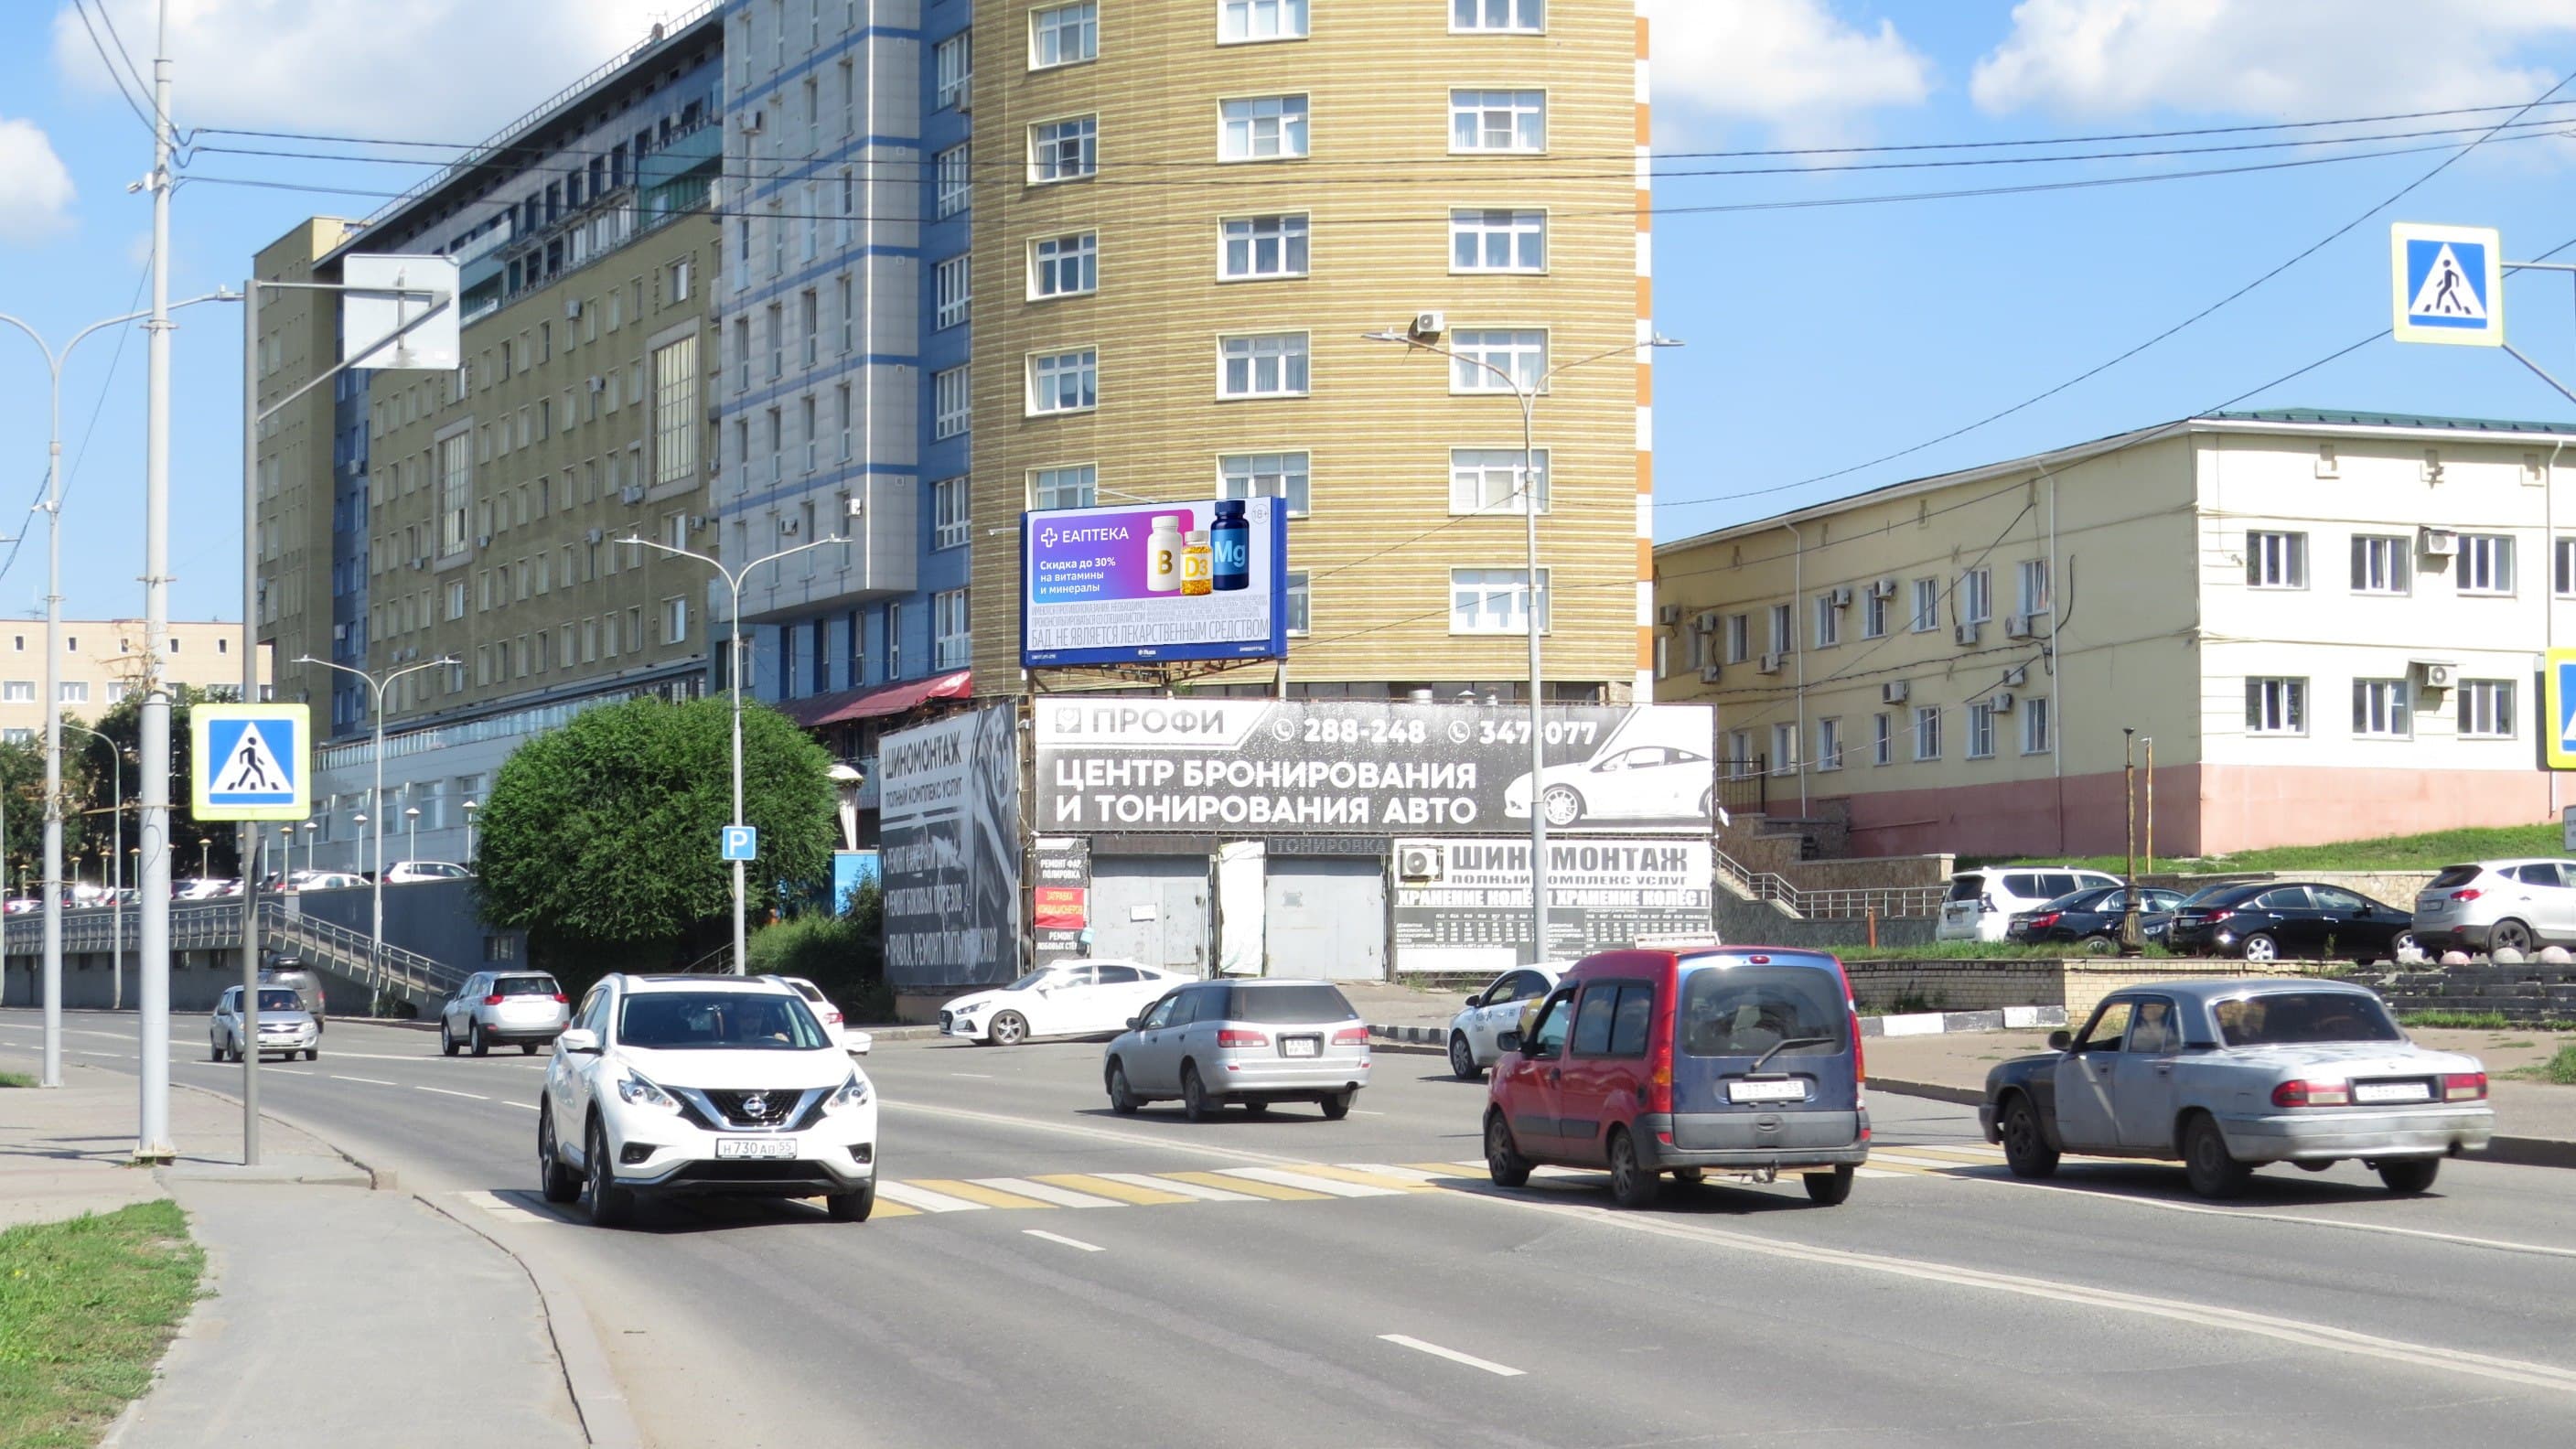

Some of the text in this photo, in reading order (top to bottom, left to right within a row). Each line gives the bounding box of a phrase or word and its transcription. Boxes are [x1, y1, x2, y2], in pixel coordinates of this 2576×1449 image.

[1062, 527, 1129, 542] ЕАПТЕКА
[1040, 556, 1116, 571] Скидка до 30%
[1214, 541, 1245, 567] Mg
[1185, 556, 1208, 577] D3
[1055, 572, 1104, 582] витамины
[1040, 585, 1100, 595] и минералы
[1032, 618, 1269, 649] БАД. НЕ ЯВЛЯЕТСЯ ЛЕКАРСТВЕННЫМ СРЕДСТВОМ
[1093, 708, 1224, 734] ПРОФИ
[1304, 719, 1597, 744] 288-248 347077
[885, 731, 961, 779] ШИНОМОНТАЖ
[1056, 759, 1476, 791] ЦЕНТР БРОНИРОВАНИЯ
[1057, 795, 1477, 823] И ТОНИРОВАНИЯ АВТО
[729, 831, 747, 856] P
[1272, 839, 1387, 853] ТОНИРОВКА
[1041, 859, 1081, 868] РЕМОНТ ФАР
[1453, 846, 1688, 872] ШИНМОНТАЖ
[1042, 870, 1081, 879] ПОЛИРОВКА
[1534, 875, 1631, 886] ОМПЛЕКС
[1636, 875, 1686, 886] УСЛУГ
[1398, 889, 1484, 905] ХРАНЕНИЕ
[1487, 887, 1534, 905] КОЛЁ
[1557, 890, 1638, 906] ХРАНЕНИЕ
[1642, 887, 1697, 906] КОЛЁС
[1049, 931, 1074, 940] РЕМОНТ
